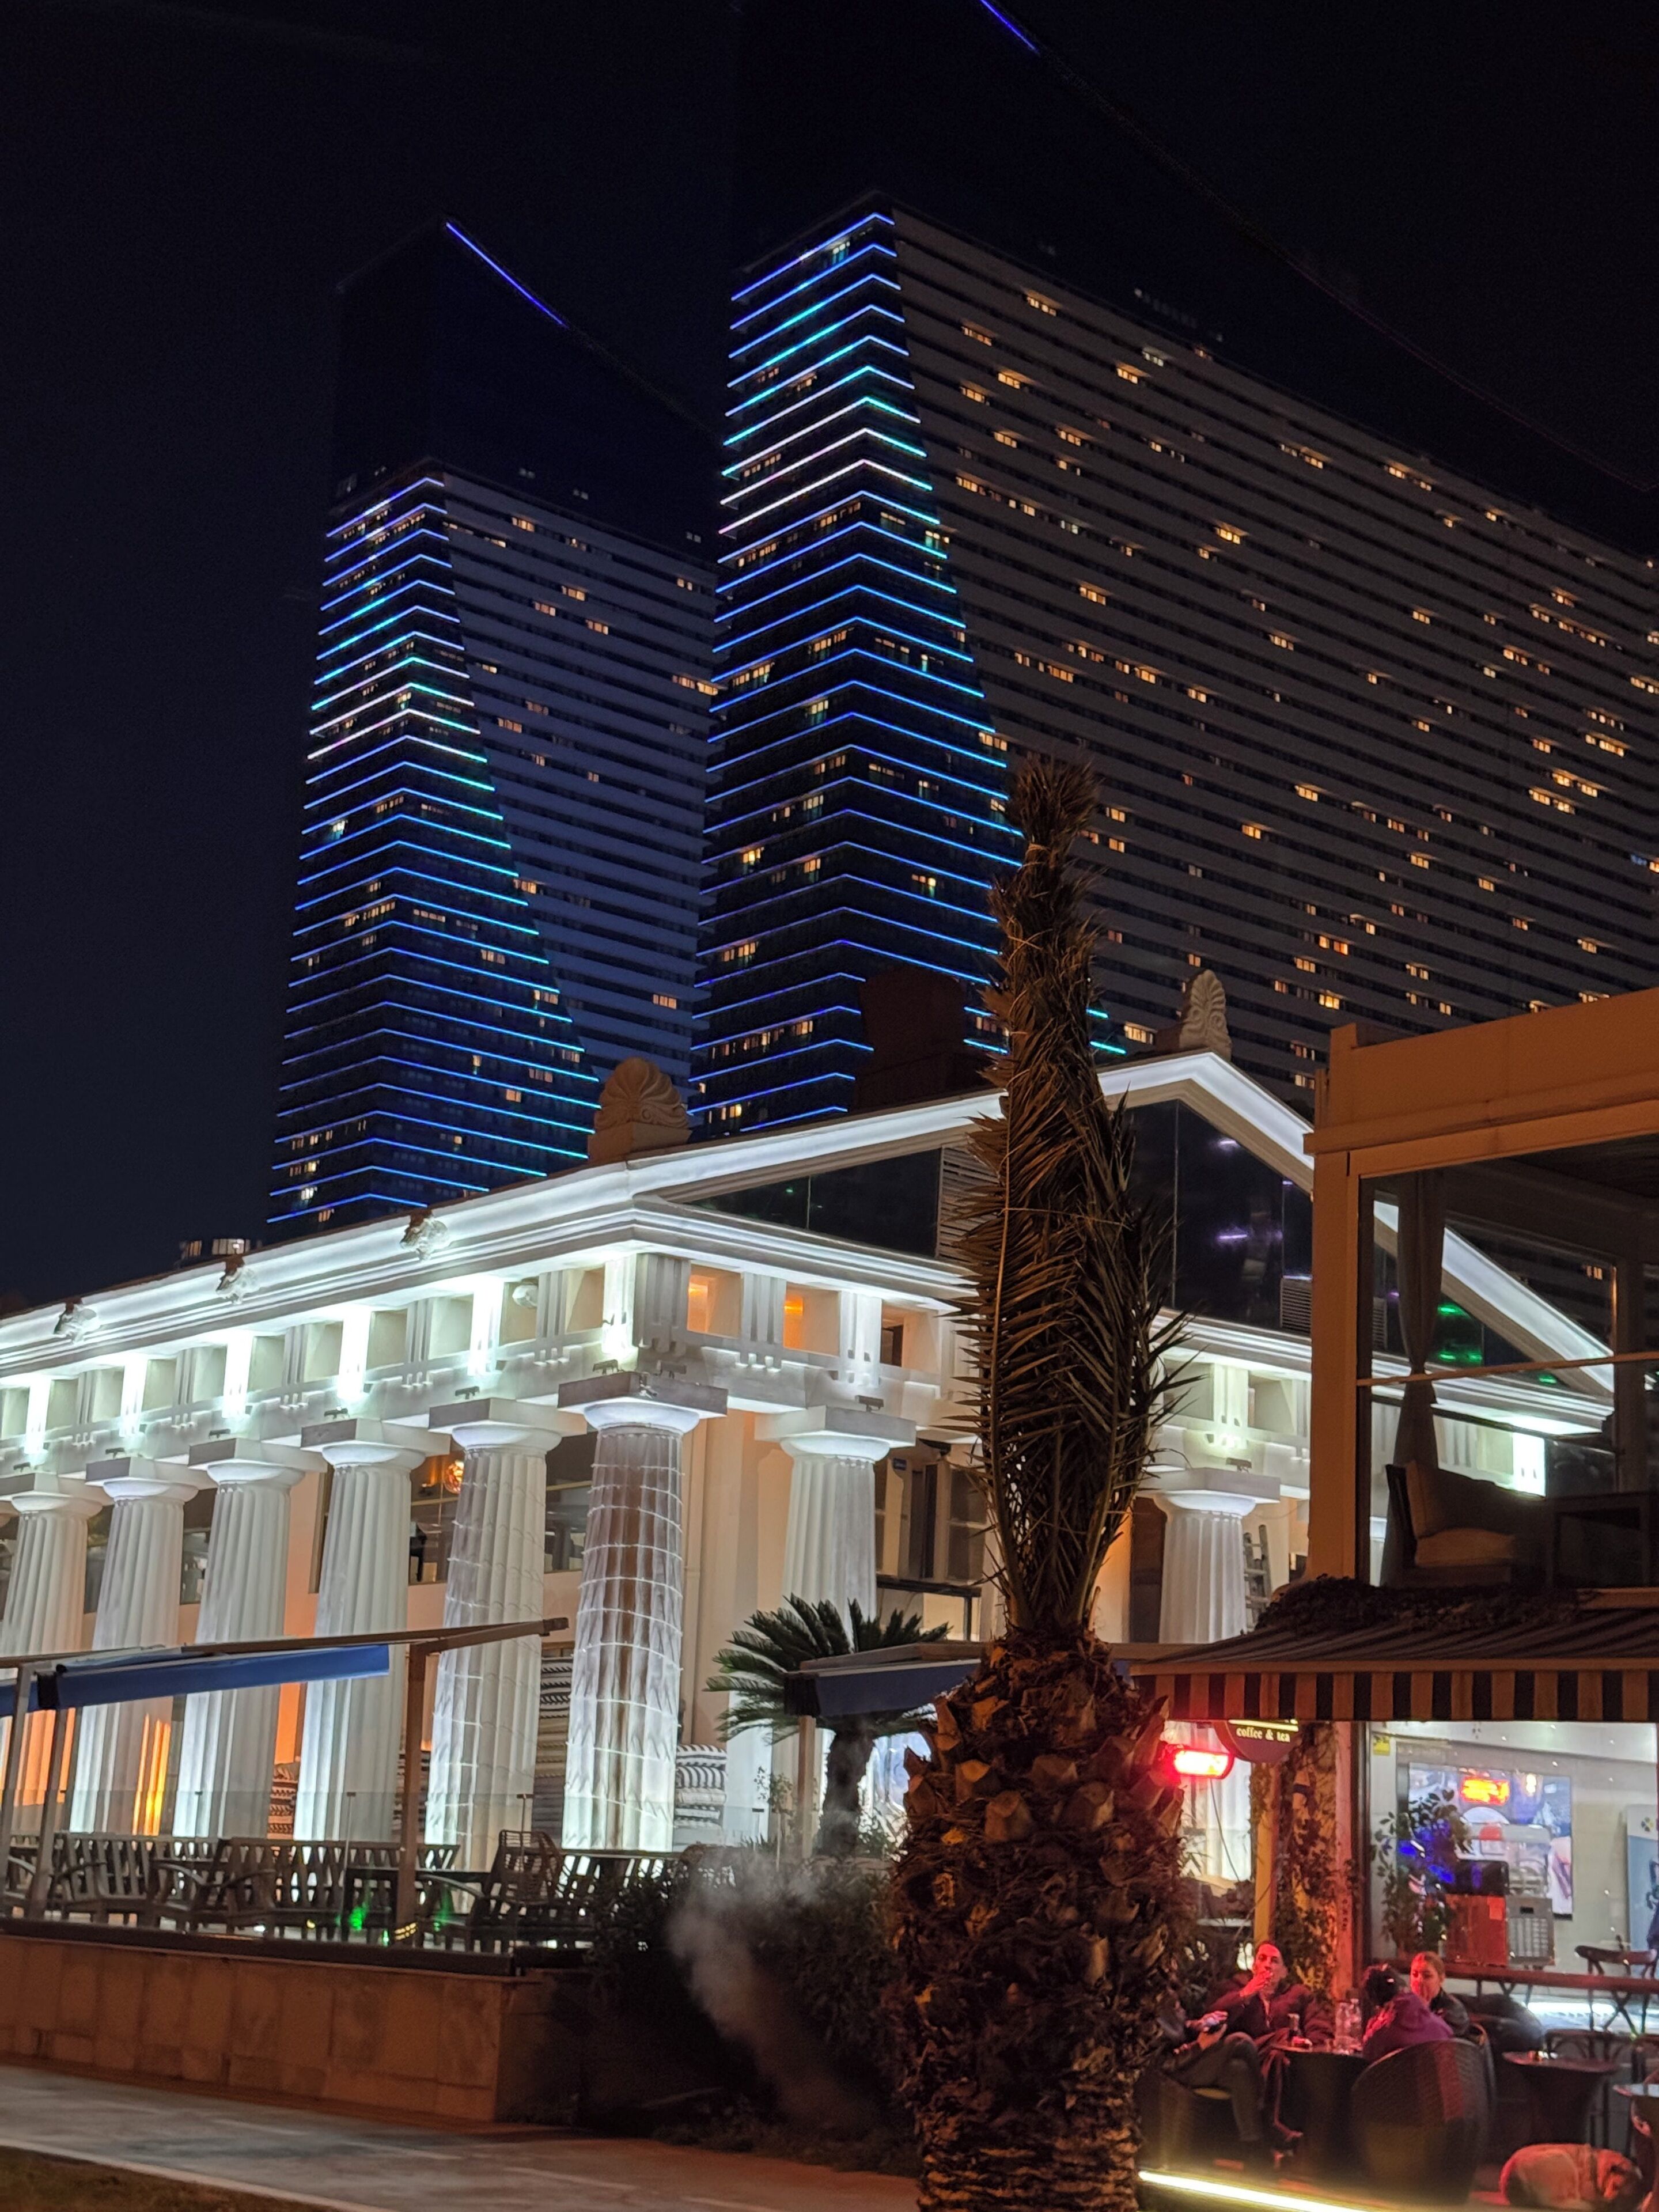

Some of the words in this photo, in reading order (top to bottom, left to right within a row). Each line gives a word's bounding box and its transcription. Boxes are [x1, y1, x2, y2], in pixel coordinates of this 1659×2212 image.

[1236, 1726, 1263, 1740] coffee
[1265, 1729, 1274, 1741] &
[1277, 1732, 1290, 1743] tea
